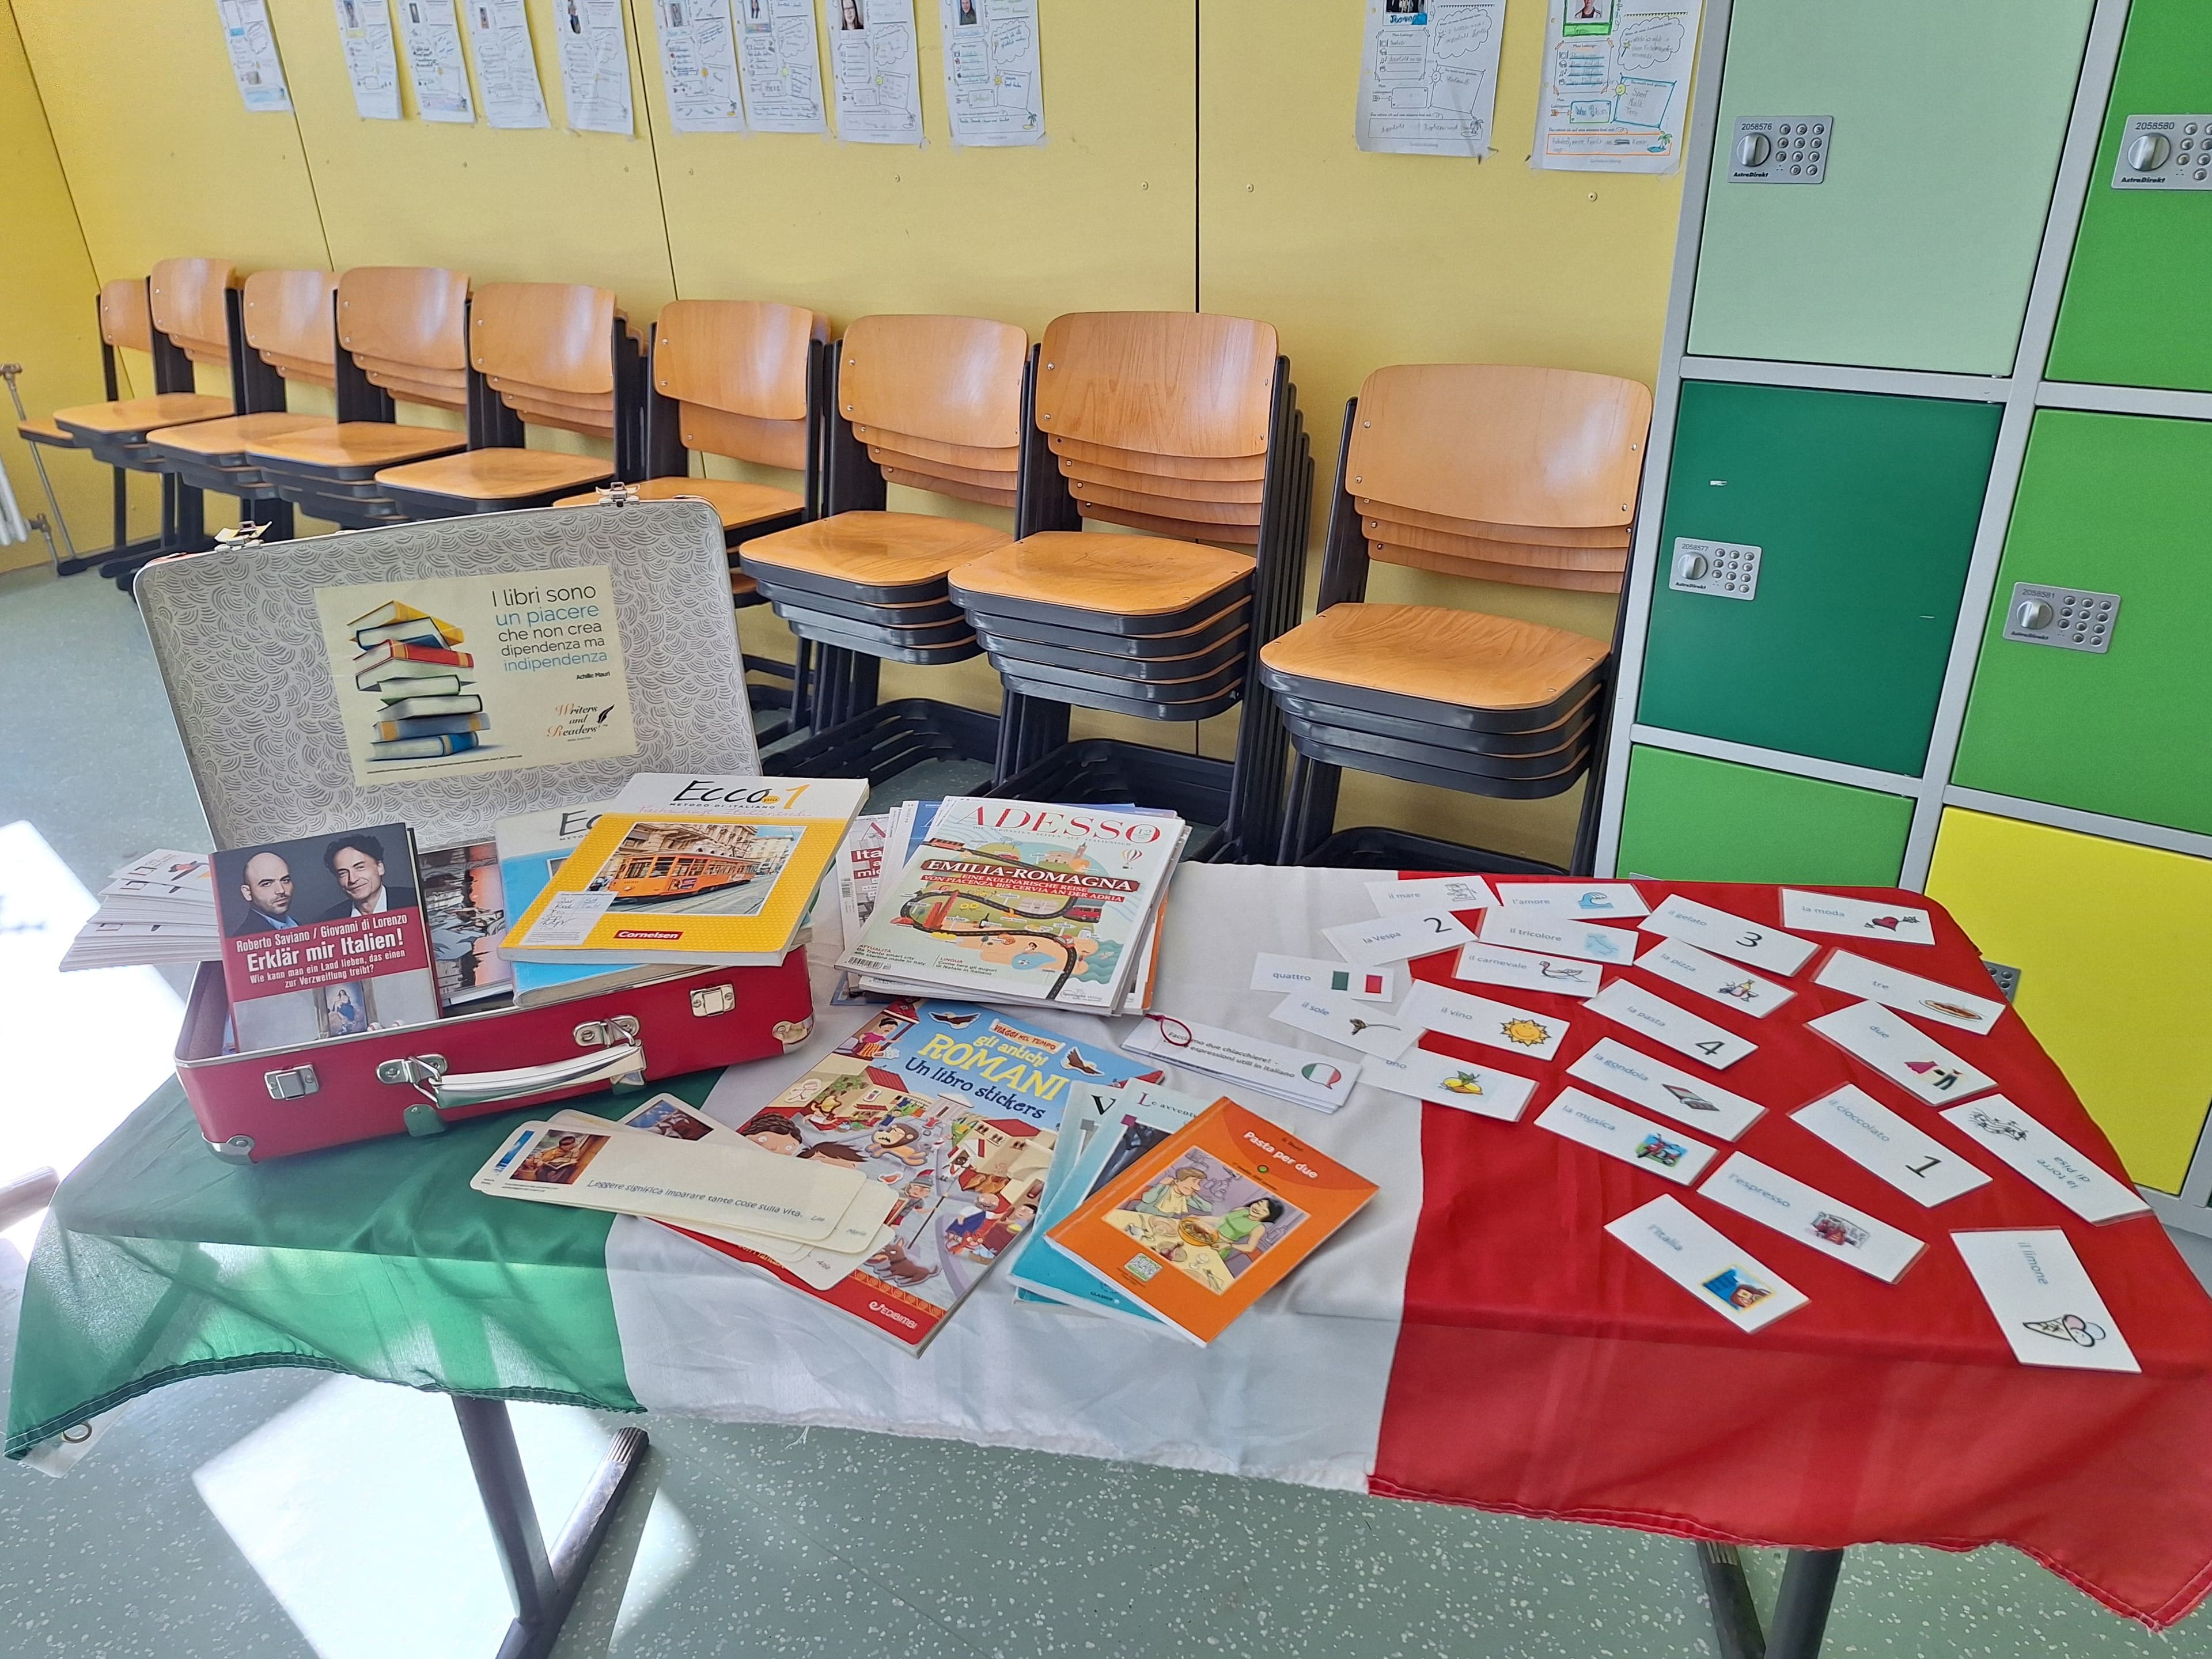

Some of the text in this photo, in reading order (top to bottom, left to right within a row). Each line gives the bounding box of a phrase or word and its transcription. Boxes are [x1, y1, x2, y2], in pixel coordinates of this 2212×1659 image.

[2135, 122, 2175, 130] 2058580
[1681, 543, 1709, 551] 2058577
[492, 586, 596, 607] I libri sono
[2022, 589, 2055, 599] 2058581
[495, 605, 599, 627] un piacere
[498, 622, 602, 642] che non crea
[501, 637, 605, 658] dipendenza ma
[504, 652, 607, 672] indipendenza
[555, 703, 598, 715] Writers
[569, 714, 588, 724] and
[673, 779, 811, 809] Ecco 1
[956, 806, 1161, 843] ADESSO
[927, 860, 1134, 891] EMILIA-ROMAGNA
[985, 876, 1060, 889] KULINARISCHE
[949, 877, 993, 887] PIACENZA
[1012, 884, 1048, 894] CERVIA
[1089, 893, 1122, 902] ADRIA
[1675, 911, 1707, 927] gelato
[1814, 908, 1845, 918] moda
[236, 914, 407, 952] Roberto Saviano Giovanni di Lorenzo
[1423, 917, 1453, 933] 2
[1518, 929, 1562, 942] tricolore
[1373, 931, 1402, 944] Vespa
[1735, 931, 1764, 948] 3
[247, 927, 404, 972] Erklär mir Italien!
[858, 944, 891, 953] ATTUALITÀ
[249, 949, 406, 984] Wie kann man ein Land lieben, das einen
[1476, 956, 1528, 969] carnevale
[1660, 953, 1696, 973] la pizza
[285, 964, 374, 988] zur Verzweiflung treibt?
[1272, 971, 1311, 982] quattro
[1872, 980, 1889, 990] tre
[1301, 1001, 1330, 1017] il sole
[1441, 1006, 1473, 1020] il vino
[1627, 1005, 1666, 1028] la pasta
[994, 1025, 1019, 1038] VIAGGI
[1032, 1037, 1056, 1050] TEMPO
[1869, 1023, 1891, 1039] due
[973, 1036, 1049, 1067] gli antichi
[1222, 1047, 1272, 1063] chiacchiere!
[1695, 1040, 1726, 1056] 4
[917, 1033, 1070, 1101] ROMANI
[1190, 1046, 1236, 1061] espressioni
[1236, 1058, 1253, 1066] utili
[1263, 1065, 1295, 1078] italiano
[1593, 1052, 1649, 1081] la gondola
[904, 1056, 1047, 1119] Un libro stickers
[1137, 1092, 1157, 1107] Le
[1562, 1104, 1616, 1131] la musica
[1827, 1098, 1890, 1143] il cioccolato
[1243, 1131, 1275, 1153] Pasta
[1272, 1150, 1296, 1165] per
[1295, 1162, 1319, 1179] due
[1905, 1154, 1942, 1179] 1
[2036, 1158, 2080, 1190] la torre
[2054, 1156, 2090, 1183] di Pisa
[587, 1180, 624, 1190] Leggere
[625, 1184, 663, 1195] significa
[664, 1188, 706, 1200] imparare
[707, 1195, 733, 1205] tante
[734, 1199, 757, 1209] cose
[758, 1203, 780, 1213] sulla
[1729, 1172, 1791, 1208] l'espresso
[2023, 1251, 2049, 1285] limone
